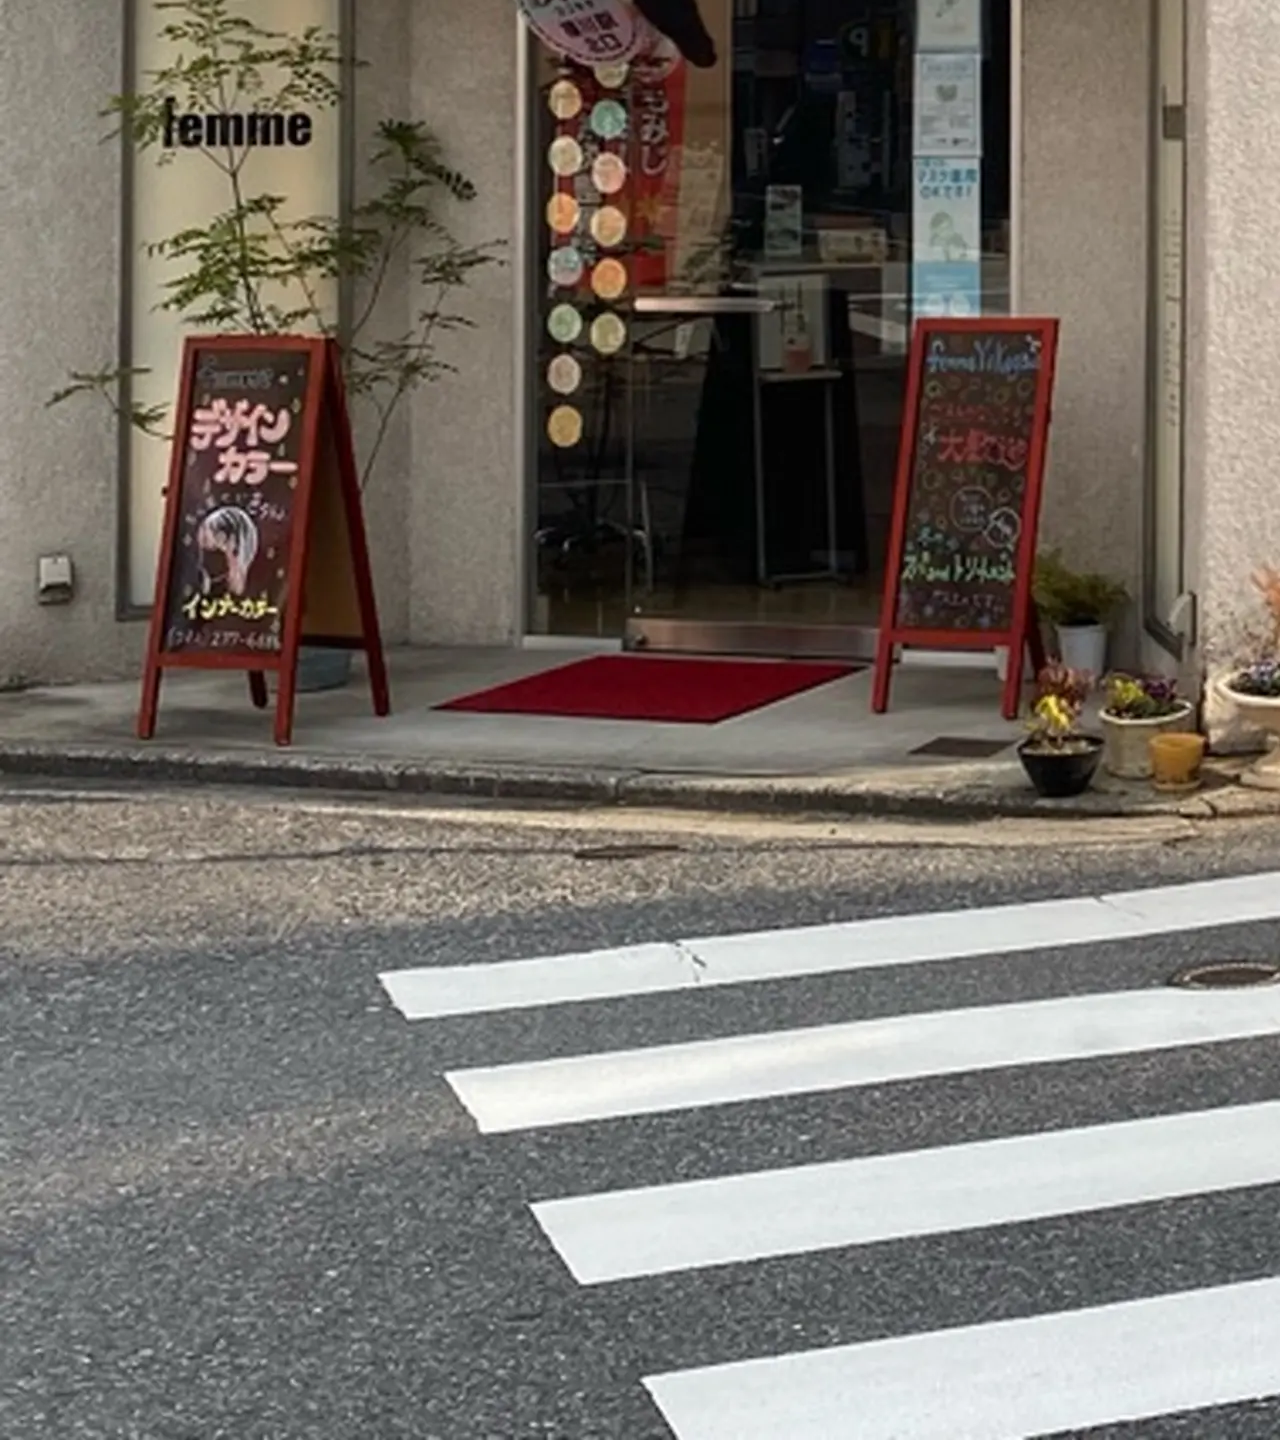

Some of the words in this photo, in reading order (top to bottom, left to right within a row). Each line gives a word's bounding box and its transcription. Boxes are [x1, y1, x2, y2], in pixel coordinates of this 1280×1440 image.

[163, 97, 312, 148] femme
[190, 398, 291, 450] デザイン
[213, 446, 298, 485] カラー
